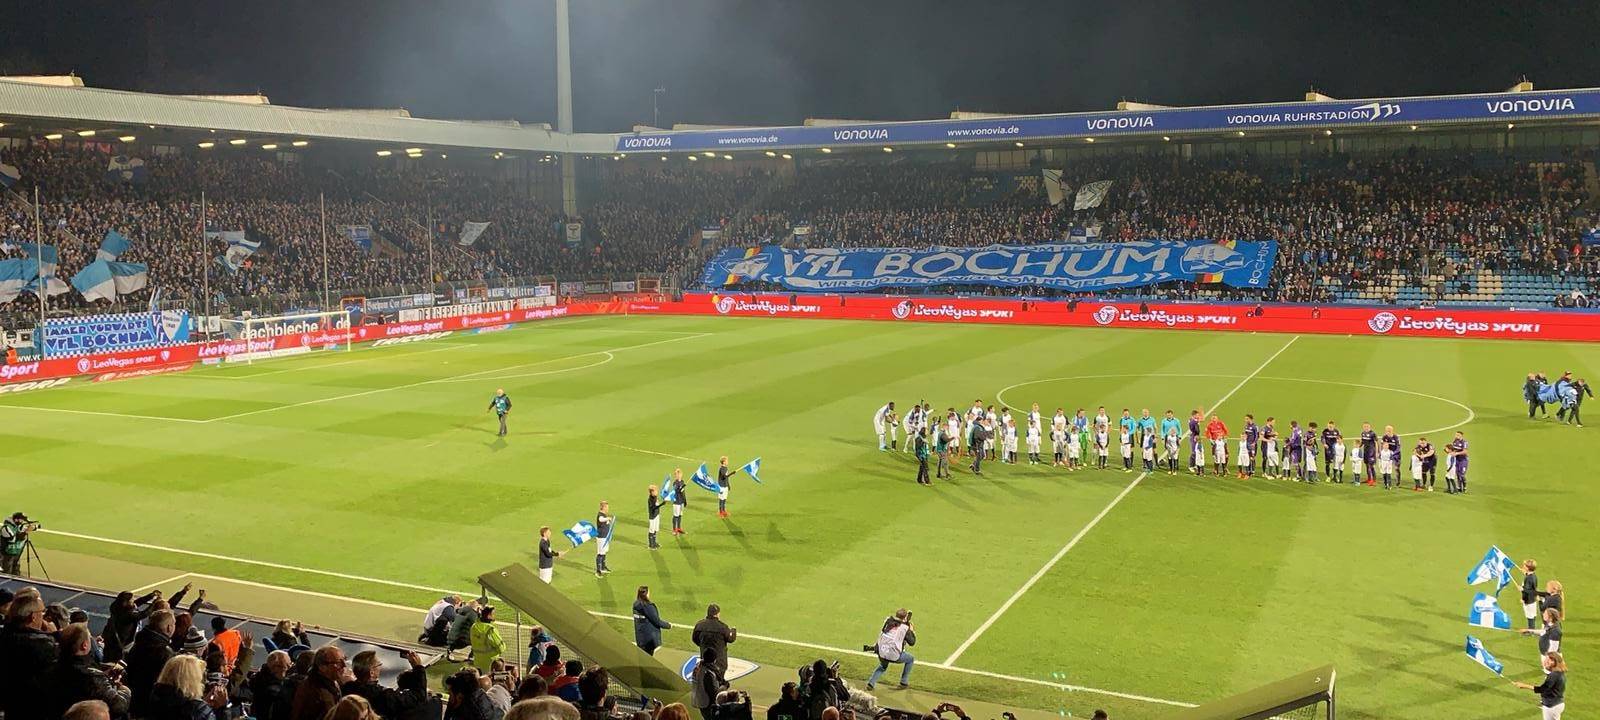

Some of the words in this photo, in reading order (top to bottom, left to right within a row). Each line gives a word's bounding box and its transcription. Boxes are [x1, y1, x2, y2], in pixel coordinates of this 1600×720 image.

[1487, 97, 1576, 113] VONOVIA
[1086, 117, 1155, 131] VONOVIA
[1227, 113, 1281, 125] VONOVIA
[1283, 109, 1371, 122] RUHRSTADION
[833, 128, 889, 141] VONOVIA
[947, 126, 1020, 138] www.vonovia.de
[624, 136, 672, 148] VONOVIA
[718, 135, 779, 146] www.vonovia.de
[784, 253, 853, 277] VfL
[873, 247, 1172, 278] BOCHUM
[1248, 241, 1270, 285] BOCHUM
[818, 279, 848, 288] WIR
[1043, 277, 1106, 289] REVIER
[735, 300, 790, 315] LeoVegas
[913, 304, 978, 319] LeoVegas
[1119, 309, 1195, 326] LeoVegas
[1398, 316, 1489, 334] LeoVegas
[45, 326, 87, 337] IMMER
[386, 324, 423, 336] LeoVegas
[422, 321, 444, 331] Sport
[81, 329, 154, 349] BOCHUM
[198, 343, 247, 357] LeoVegas
[248, 338, 276, 354] Sport
[0, 361, 40, 379] Sport
[93, 358, 135, 371] LeoVegas
[135, 355, 157, 364] SPORT
